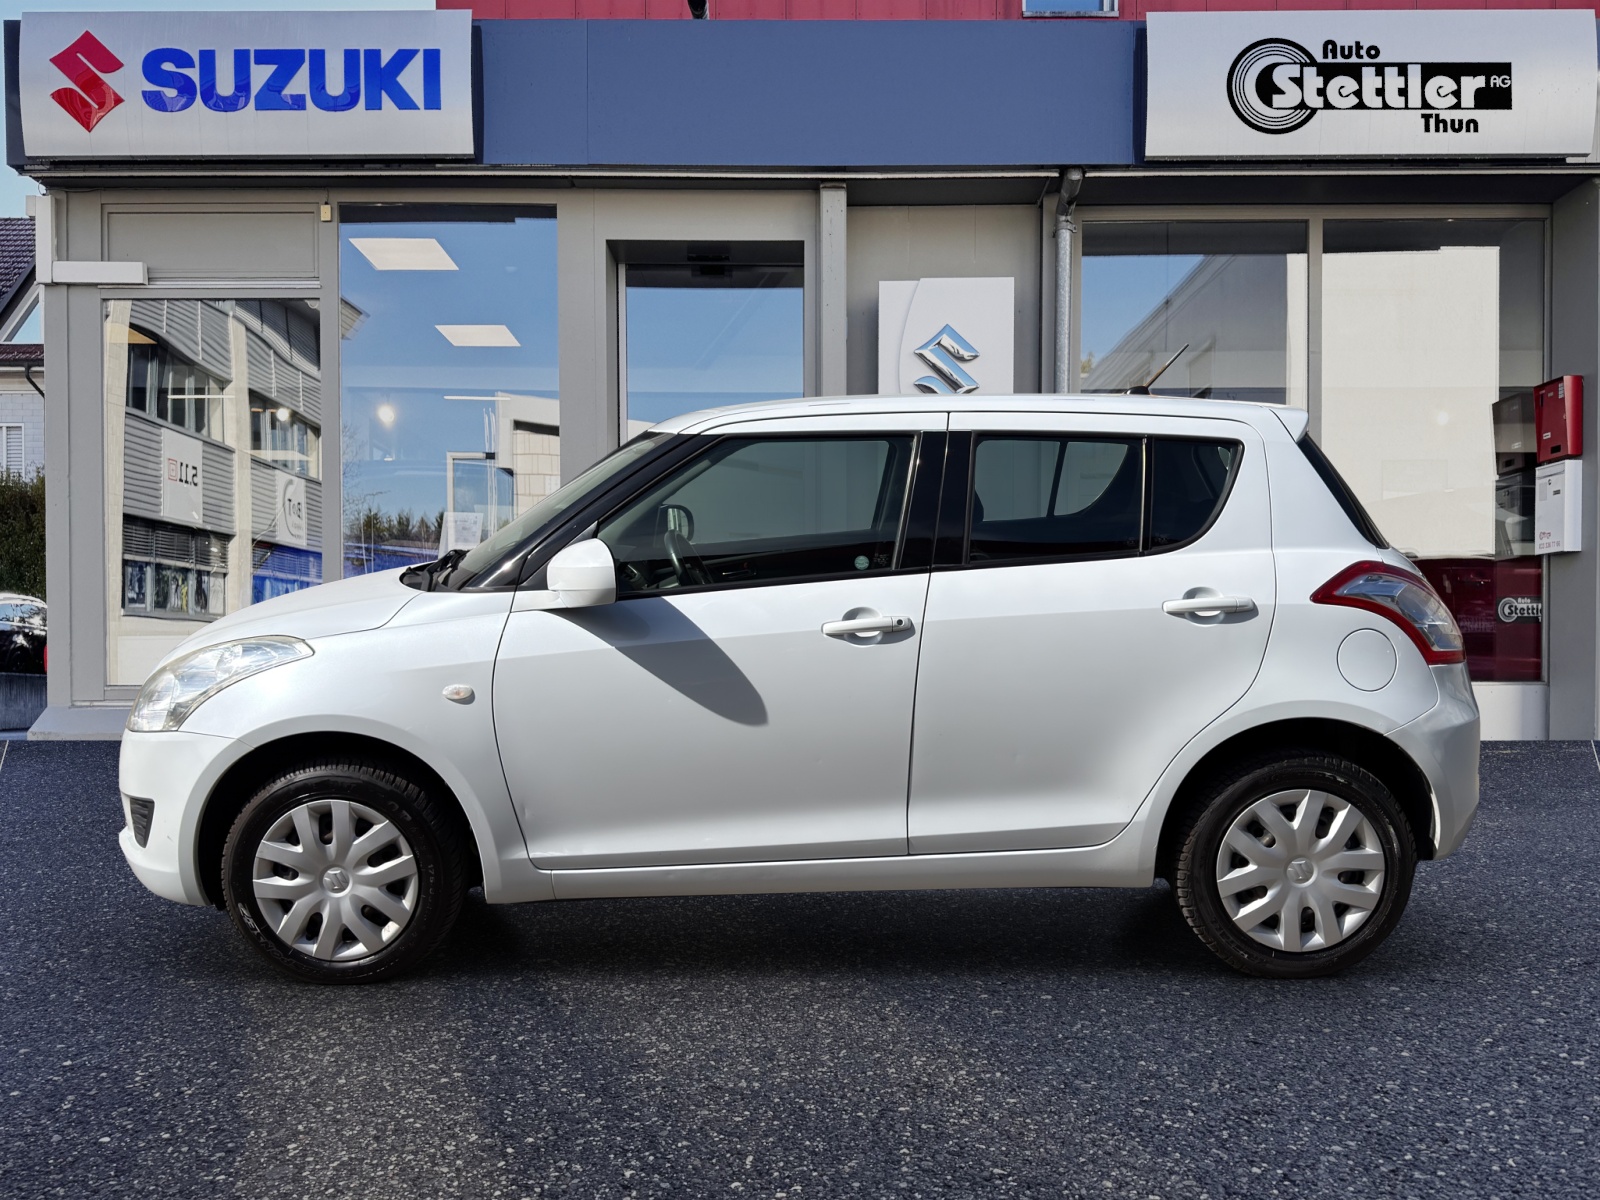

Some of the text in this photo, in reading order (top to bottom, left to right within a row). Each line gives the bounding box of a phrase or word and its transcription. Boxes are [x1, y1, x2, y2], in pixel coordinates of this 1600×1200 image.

[1322, 39, 1381, 60] Auto
[141, 47, 442, 112] SUZUKI
[1272, 64, 1512, 109] Stettler AG
[1420, 113, 1479, 133] Thun
